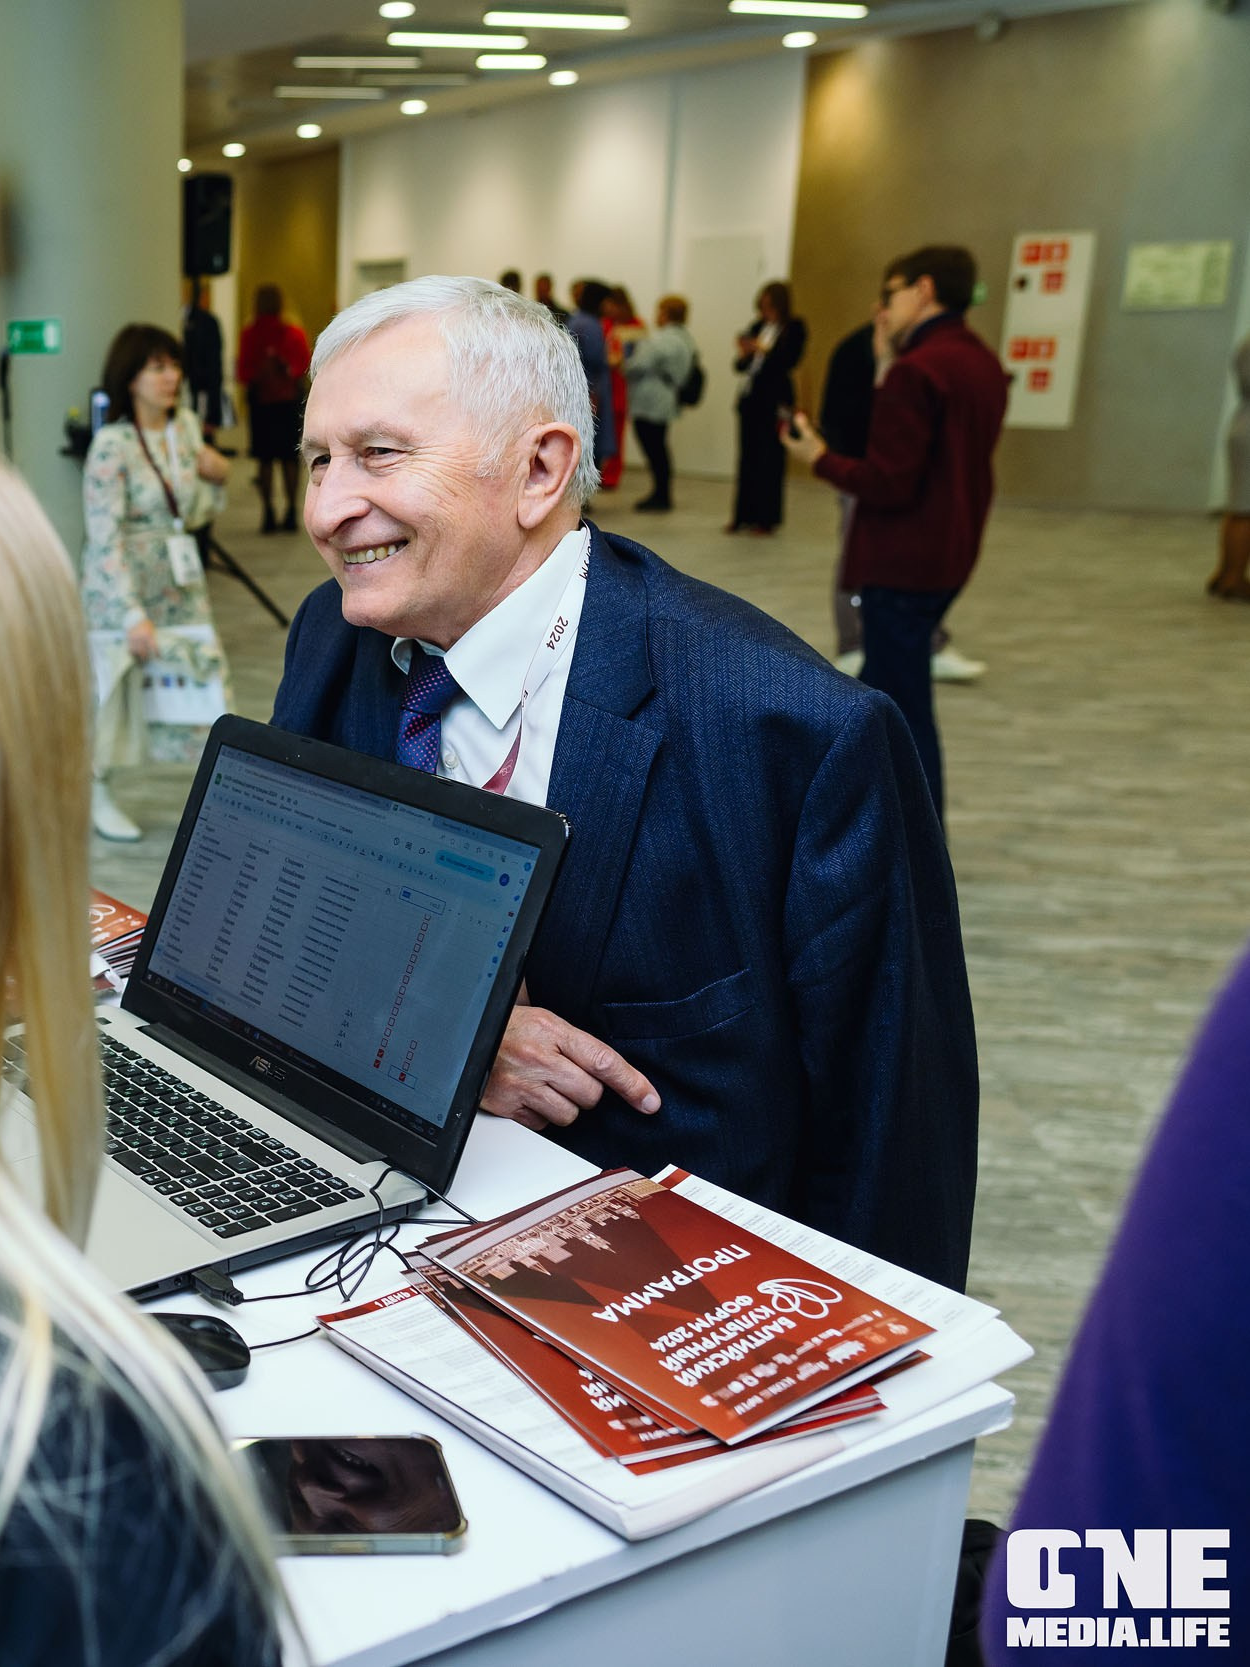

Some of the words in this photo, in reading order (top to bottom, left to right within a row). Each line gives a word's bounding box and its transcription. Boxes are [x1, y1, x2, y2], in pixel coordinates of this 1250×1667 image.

[546, 616, 569, 650] 2024
[591, 1243, 751, 1323] ПРОГРАММА
[650, 1327, 694, 1352] 2024
[658, 1305, 776, 1371] КУЛЬТУРНЫЙ
[686, 1295, 754, 1333] ФОРУМ
[674, 1316, 797, 1387] БАЛТИЙСКИЙ
